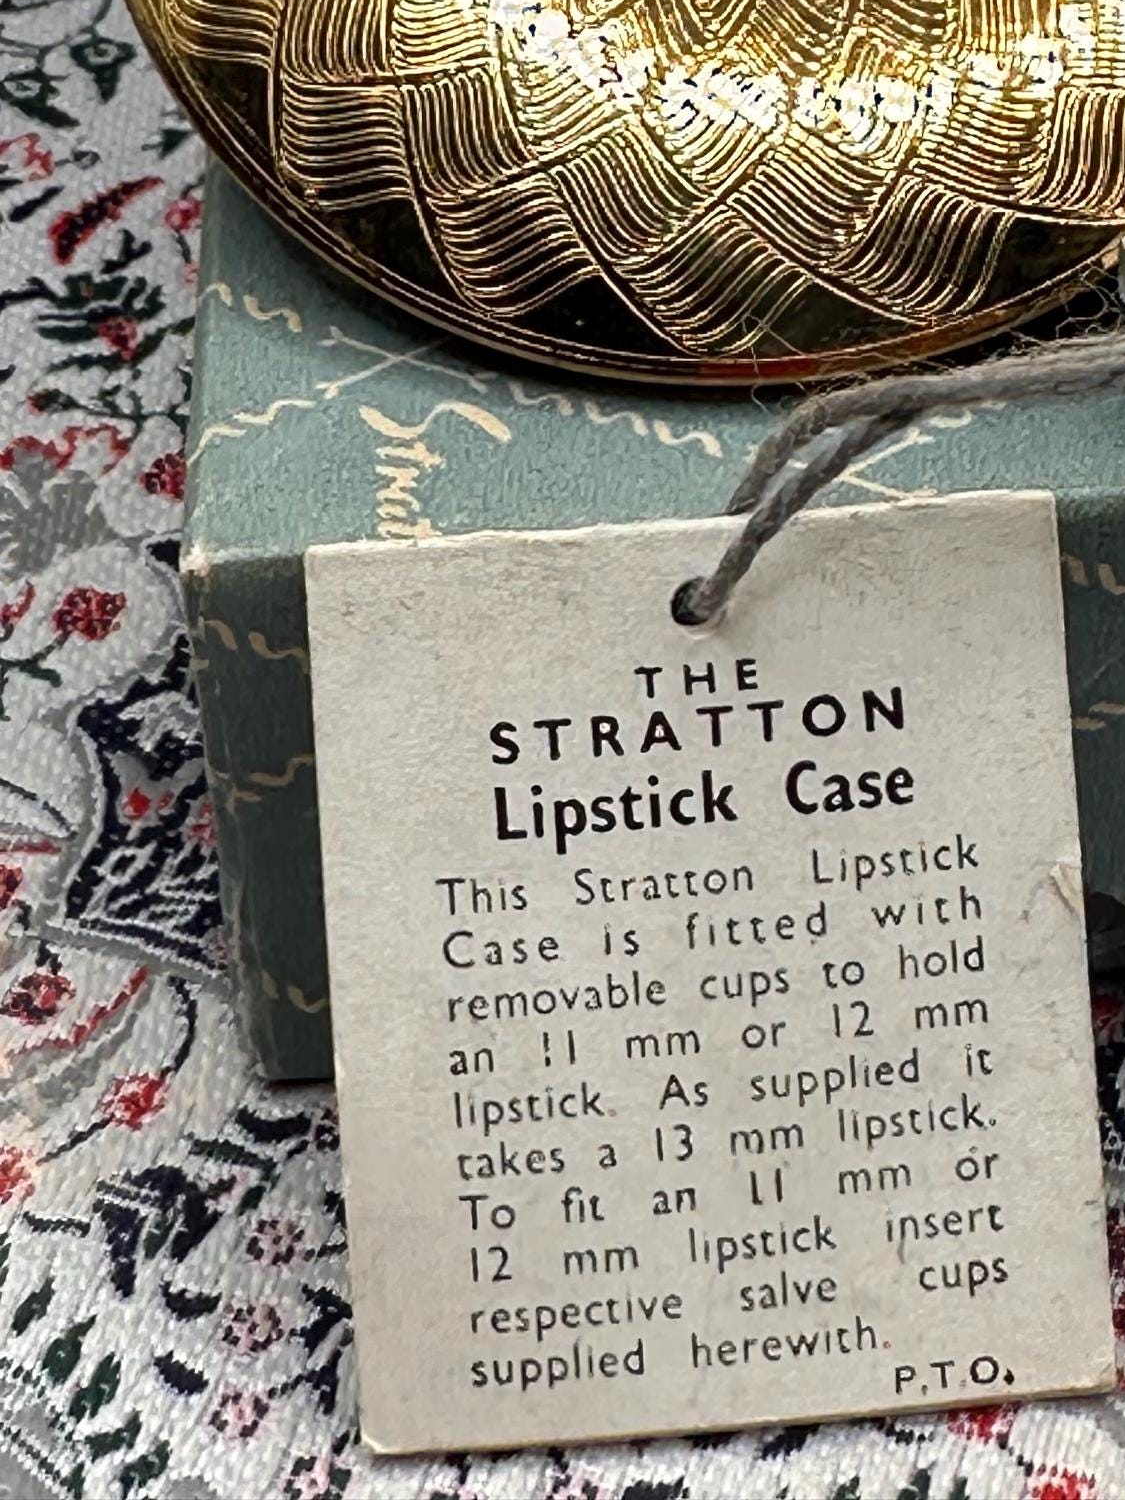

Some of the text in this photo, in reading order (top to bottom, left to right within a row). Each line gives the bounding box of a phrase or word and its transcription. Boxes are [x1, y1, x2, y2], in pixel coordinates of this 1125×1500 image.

[634, 658, 758, 699] THE
[490, 686, 904, 765] STRATTON
[494, 760, 914, 855] Lipstick Case
[435, 834, 979, 915] This Stratton Lipstick
[442, 886, 981, 969] Case is fitted with
[448, 935, 984, 1024] removable cups to hold
[449, 999, 988, 1076] an 11 mm or 12 mm
[454, 1044, 993, 1137] lipstick. As supplied it
[457, 1092, 996, 1181] takes a 13 mm lipstick.
[458, 1152, 999, 1230] To fit an 11 mm or
[471, 1205, 1004, 1282] 12 mm lipstick insert
[471, 1257, 1008, 1343] respective salve cups
[471, 1316, 891, 1392] supplied herewith.
[895, 1356, 1015, 1395] P.T.O.
